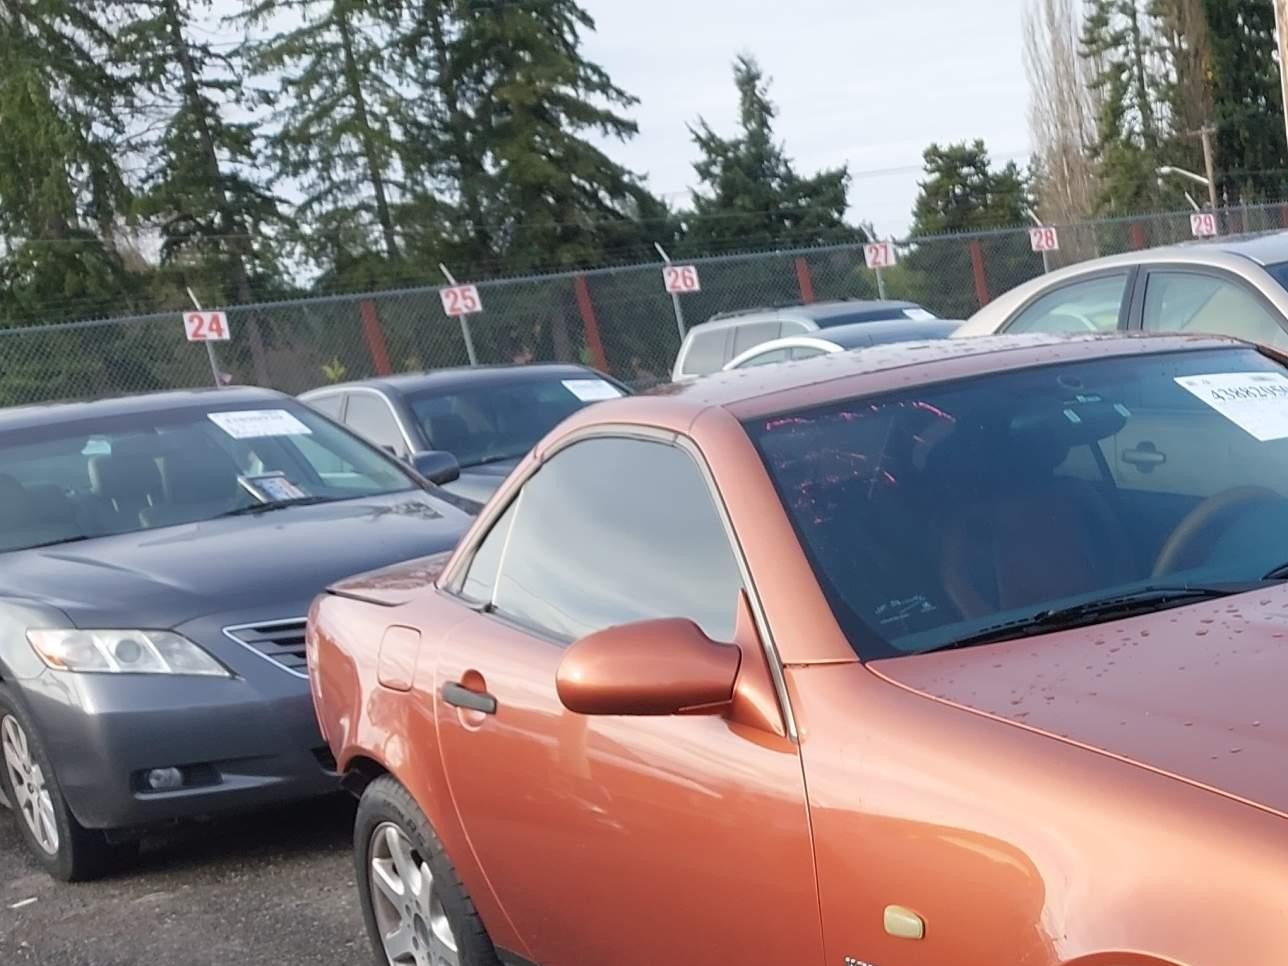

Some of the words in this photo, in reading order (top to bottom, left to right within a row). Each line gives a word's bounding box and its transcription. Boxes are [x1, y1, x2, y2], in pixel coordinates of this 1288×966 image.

[1192, 215, 1214, 235] 29
[1033, 228, 1056, 249] 28
[869, 244, 891, 266] 27
[668, 268, 695, 290] 26
[444, 289, 478, 313] 25
[188, 314, 225, 338] 24
